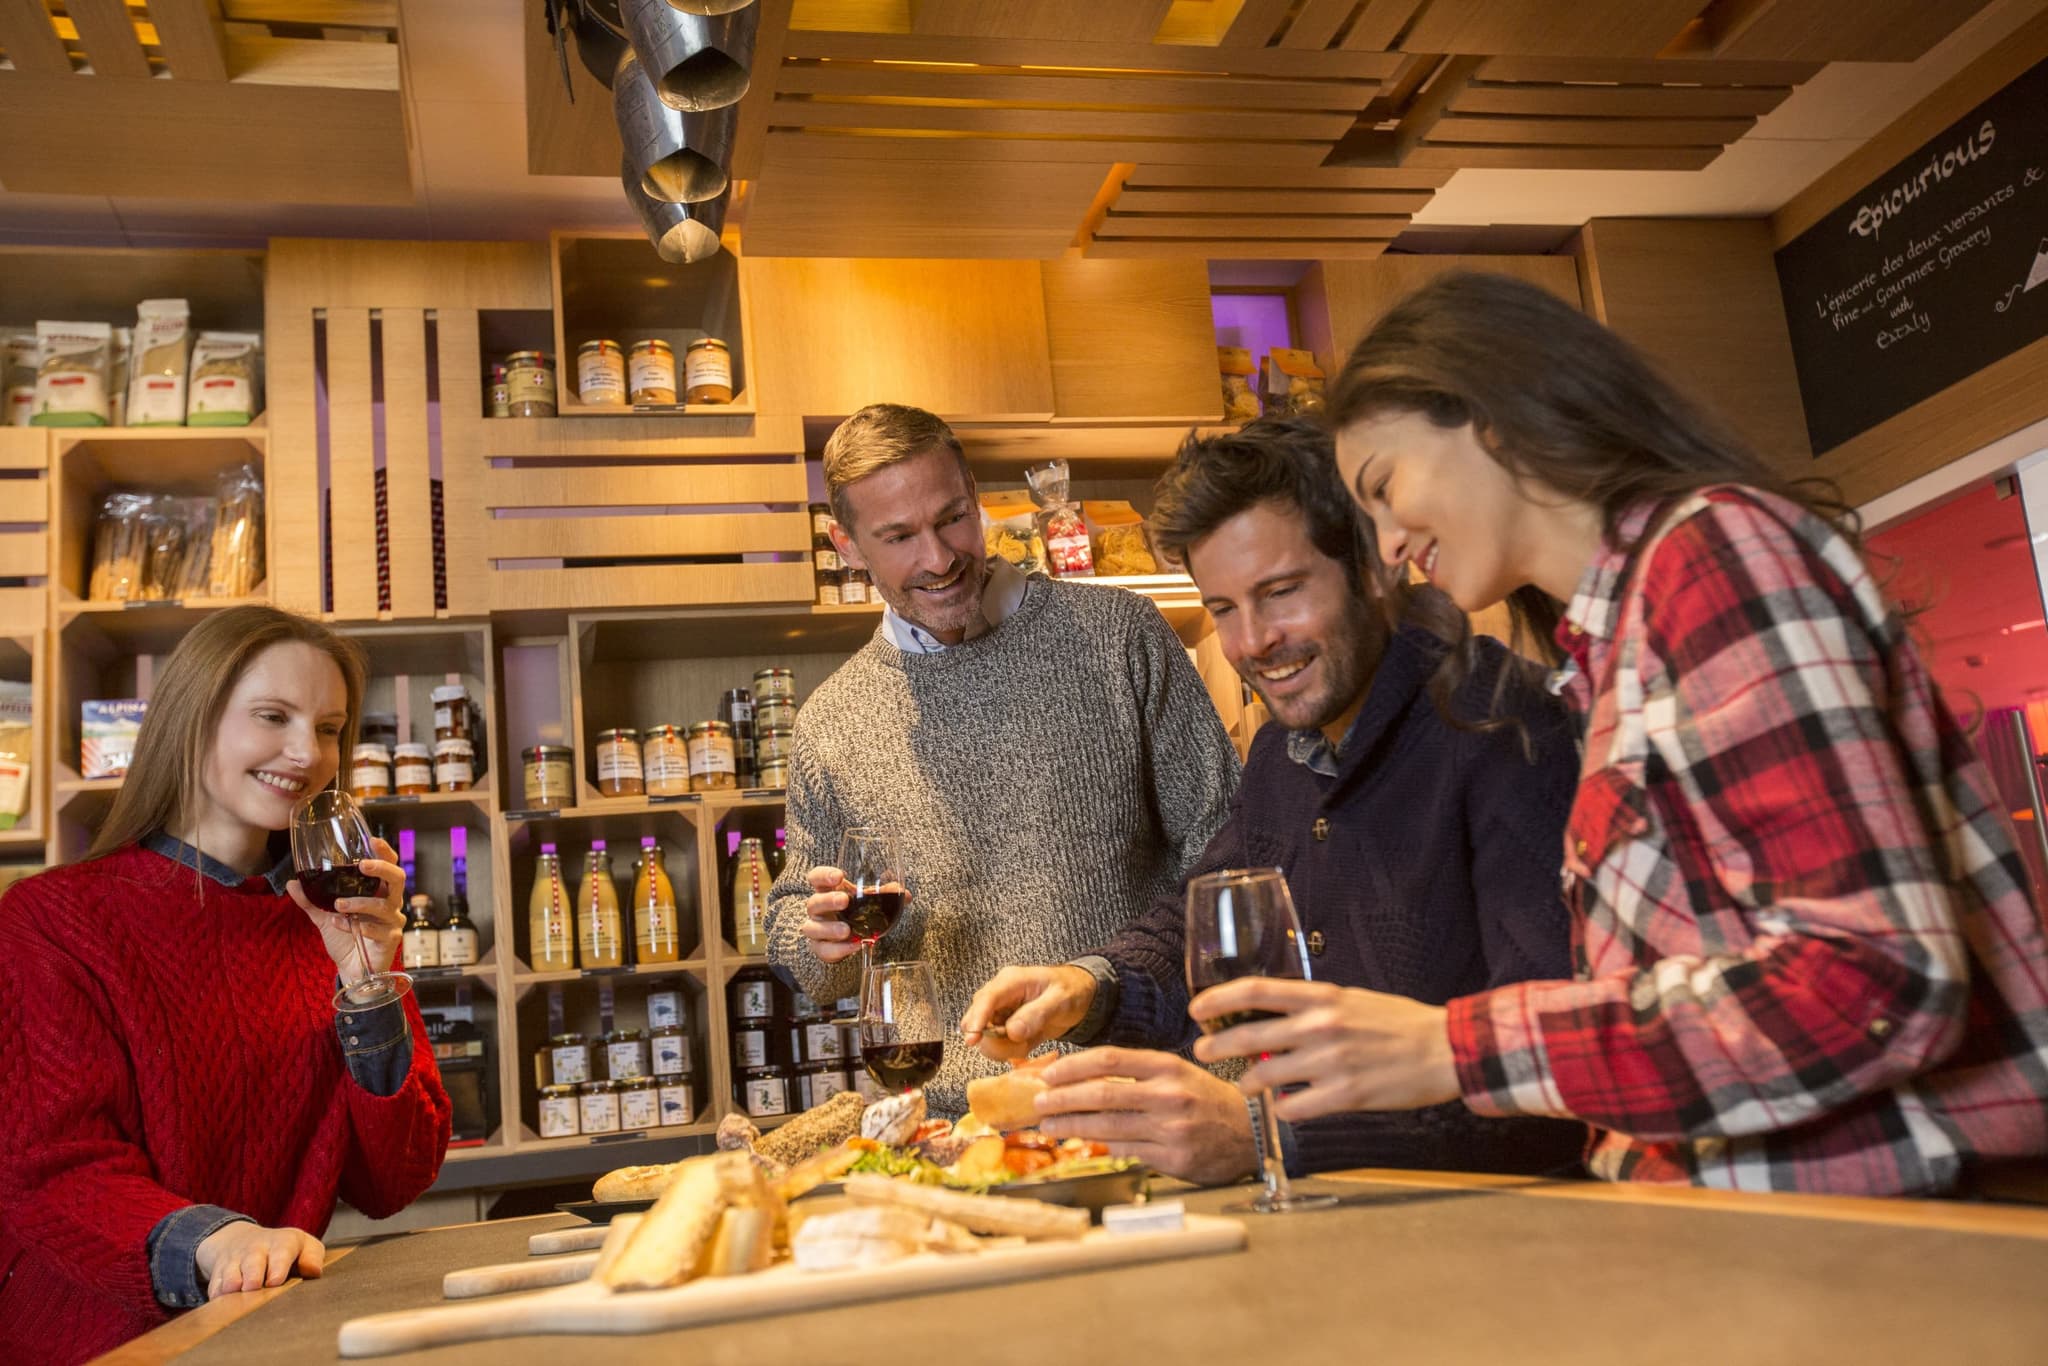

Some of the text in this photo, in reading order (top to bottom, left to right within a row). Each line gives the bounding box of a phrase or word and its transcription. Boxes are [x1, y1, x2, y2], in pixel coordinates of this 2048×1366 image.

[1881, 256, 1904, 277] des
[1906, 231, 1943, 260] deux
[2023, 167, 2045, 187] &
[1938, 226, 1992, 270] Grocery
